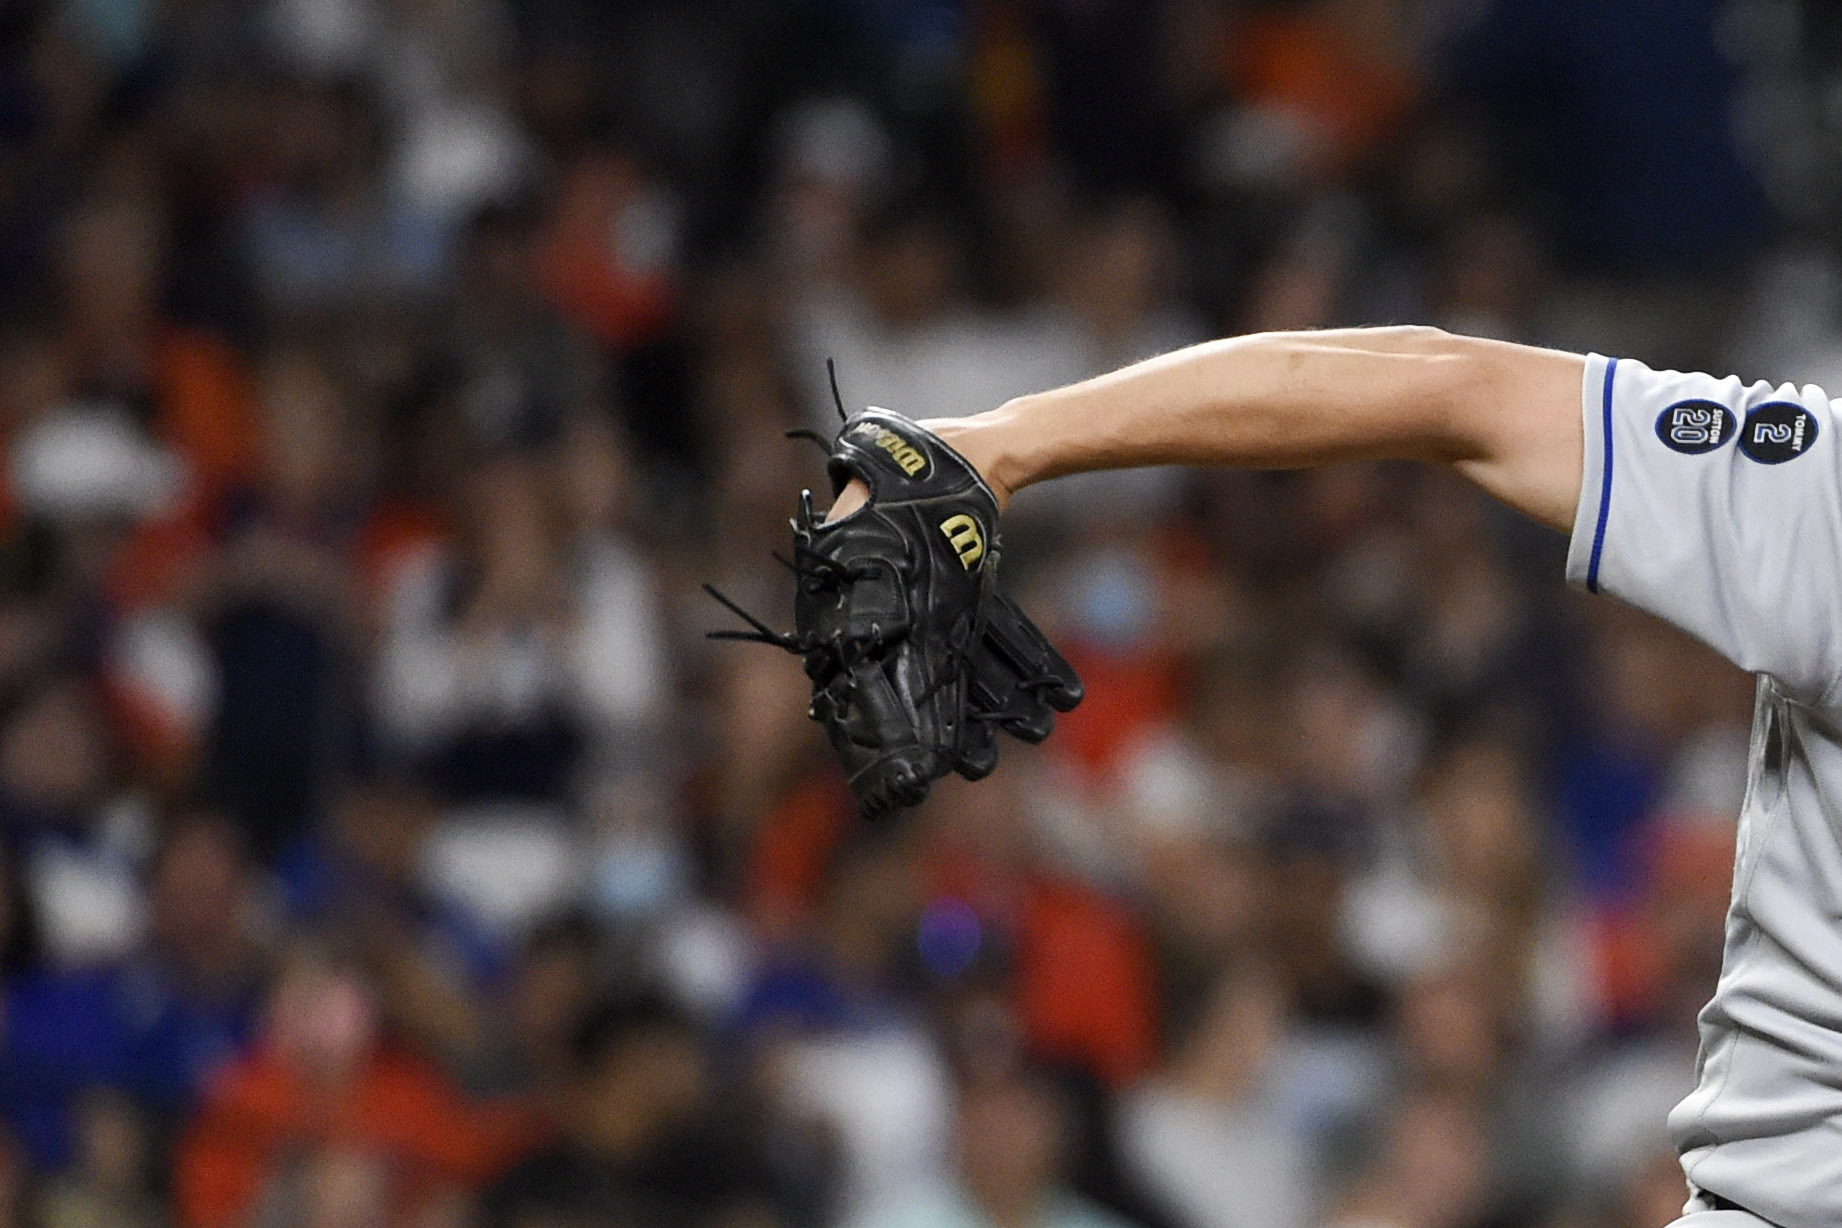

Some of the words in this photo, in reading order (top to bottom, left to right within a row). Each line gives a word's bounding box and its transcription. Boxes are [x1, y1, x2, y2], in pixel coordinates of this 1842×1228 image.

[1671, 408, 1710, 443] 20
[1709, 408, 1724, 444] SUTTON
[1753, 423, 1791, 443] 2
[1792, 413, 1806, 451] TOMMY
